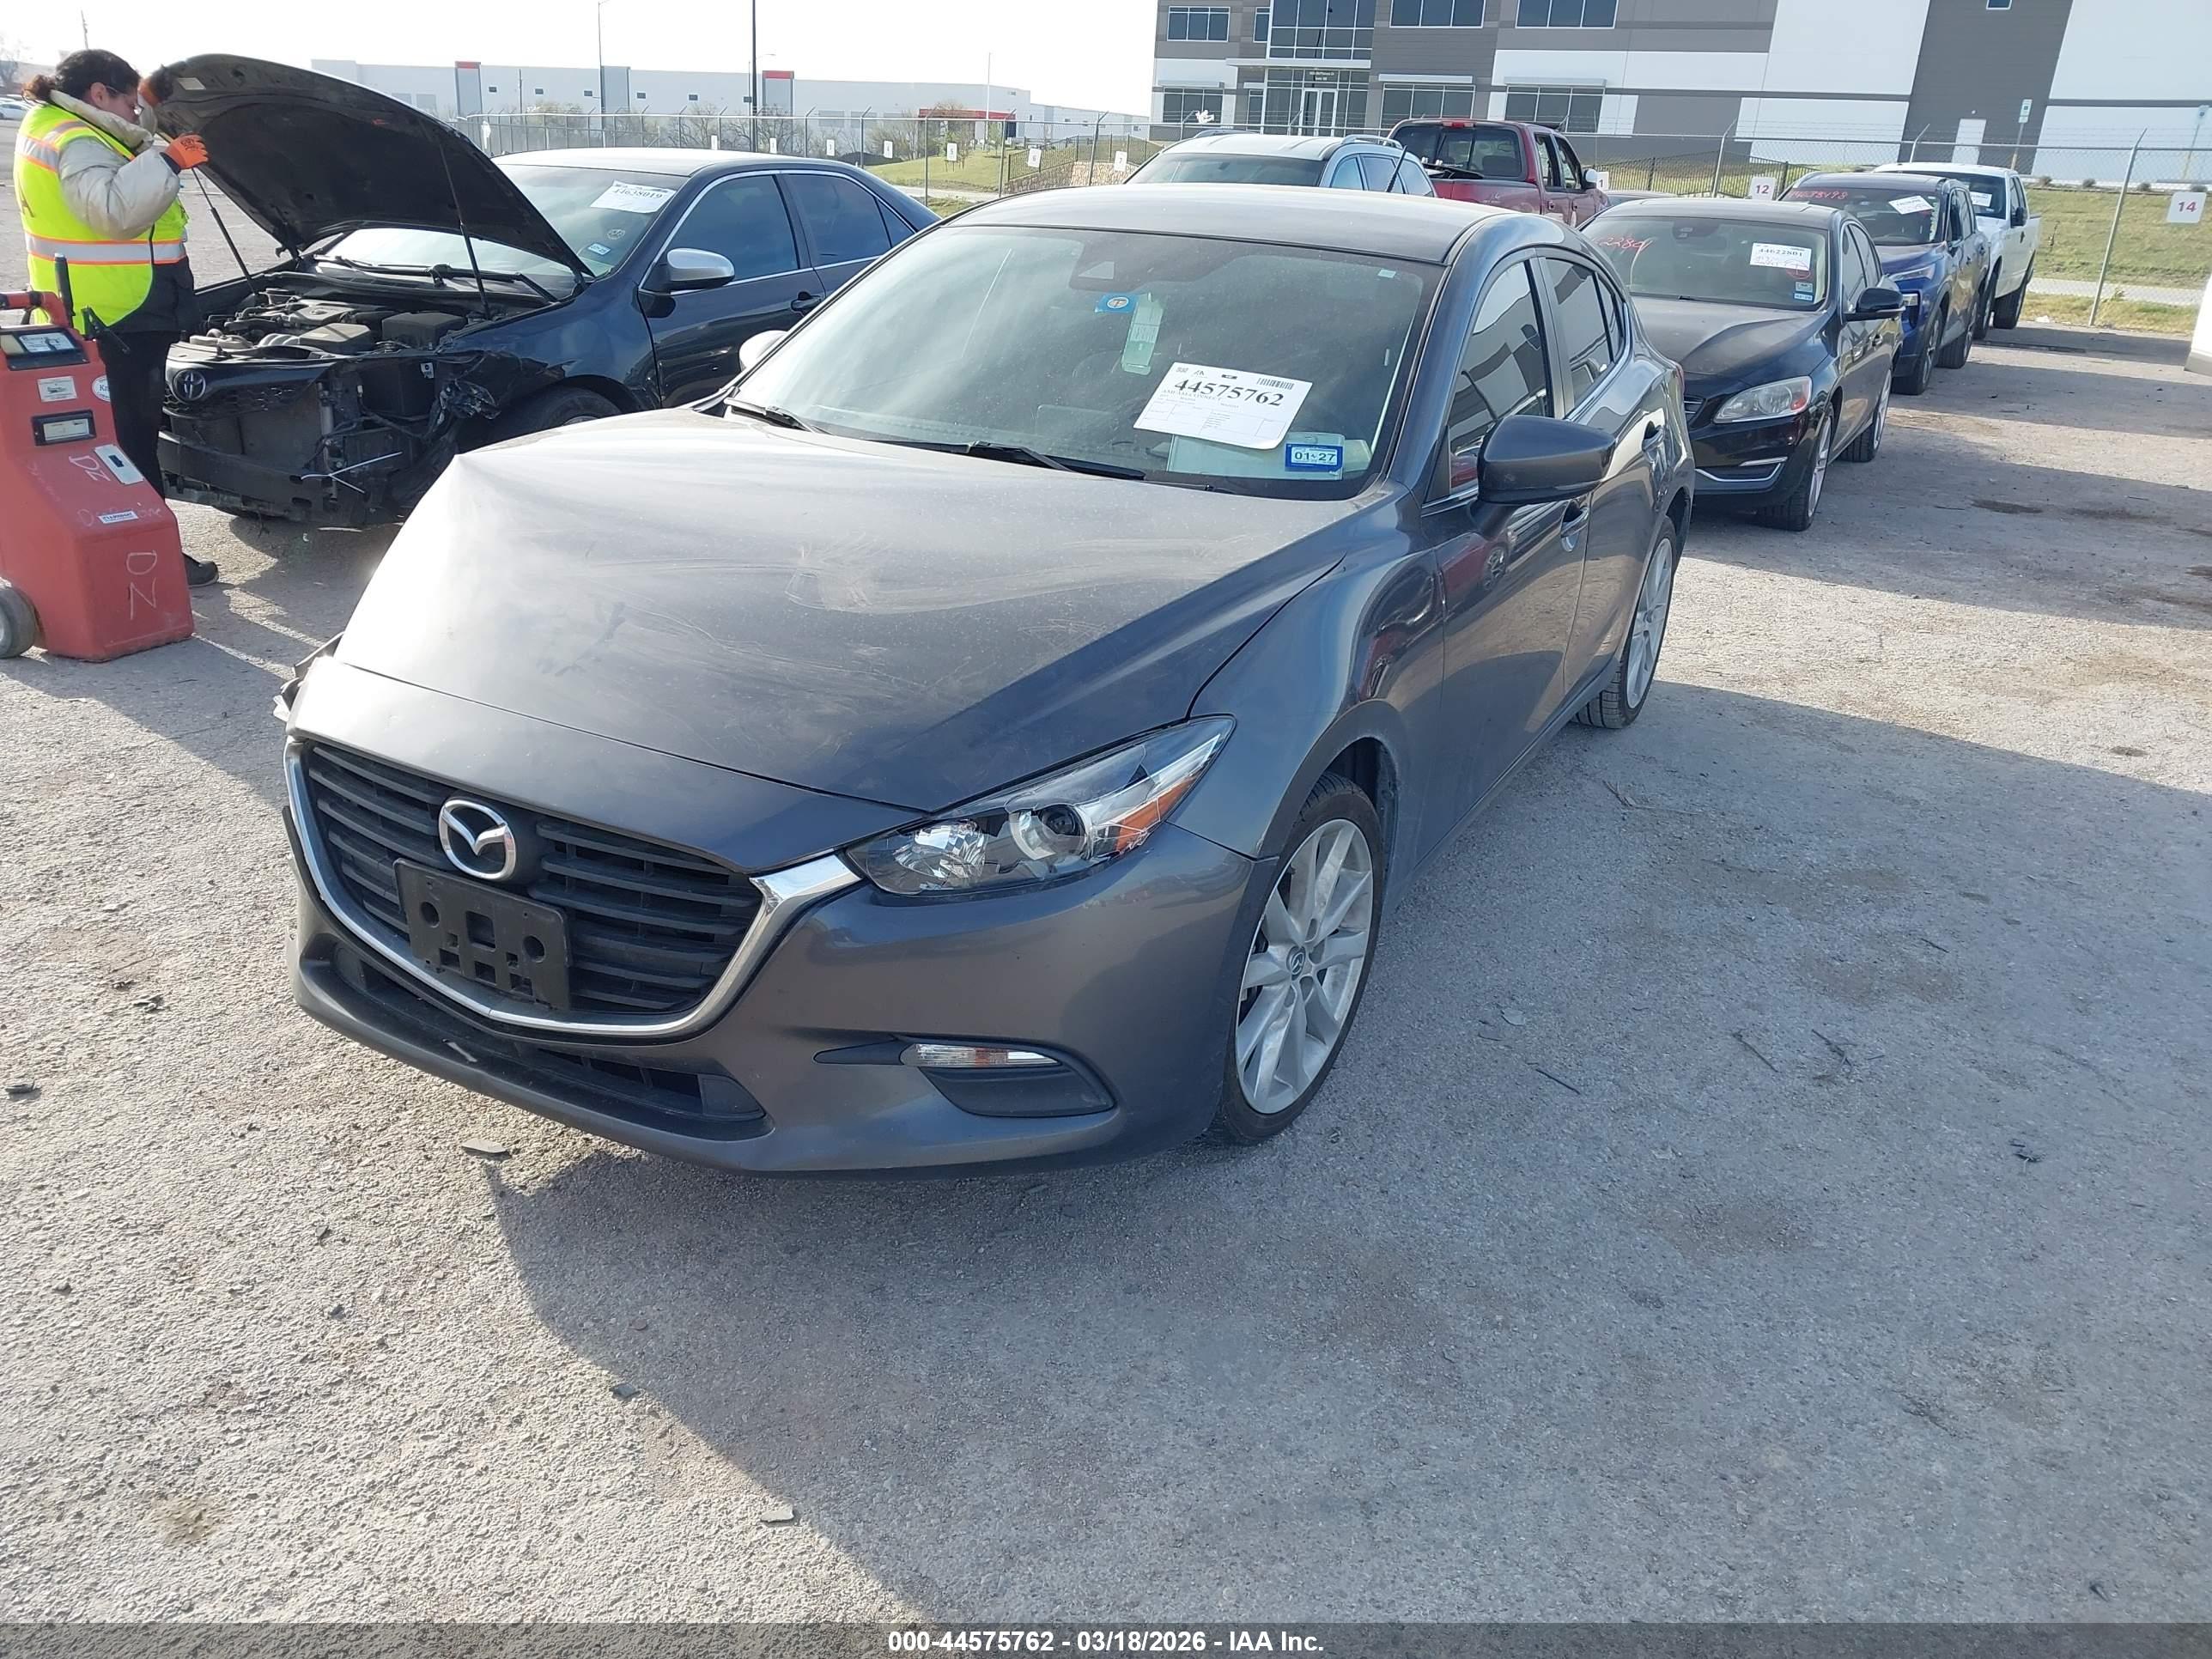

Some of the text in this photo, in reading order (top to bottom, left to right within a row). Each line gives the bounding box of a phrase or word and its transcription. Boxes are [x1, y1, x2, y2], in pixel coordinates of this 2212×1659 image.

[1755, 185, 1770, 194] 12
[2178, 201, 2197, 212] 14
[1175, 379, 1285, 407] 44575762
